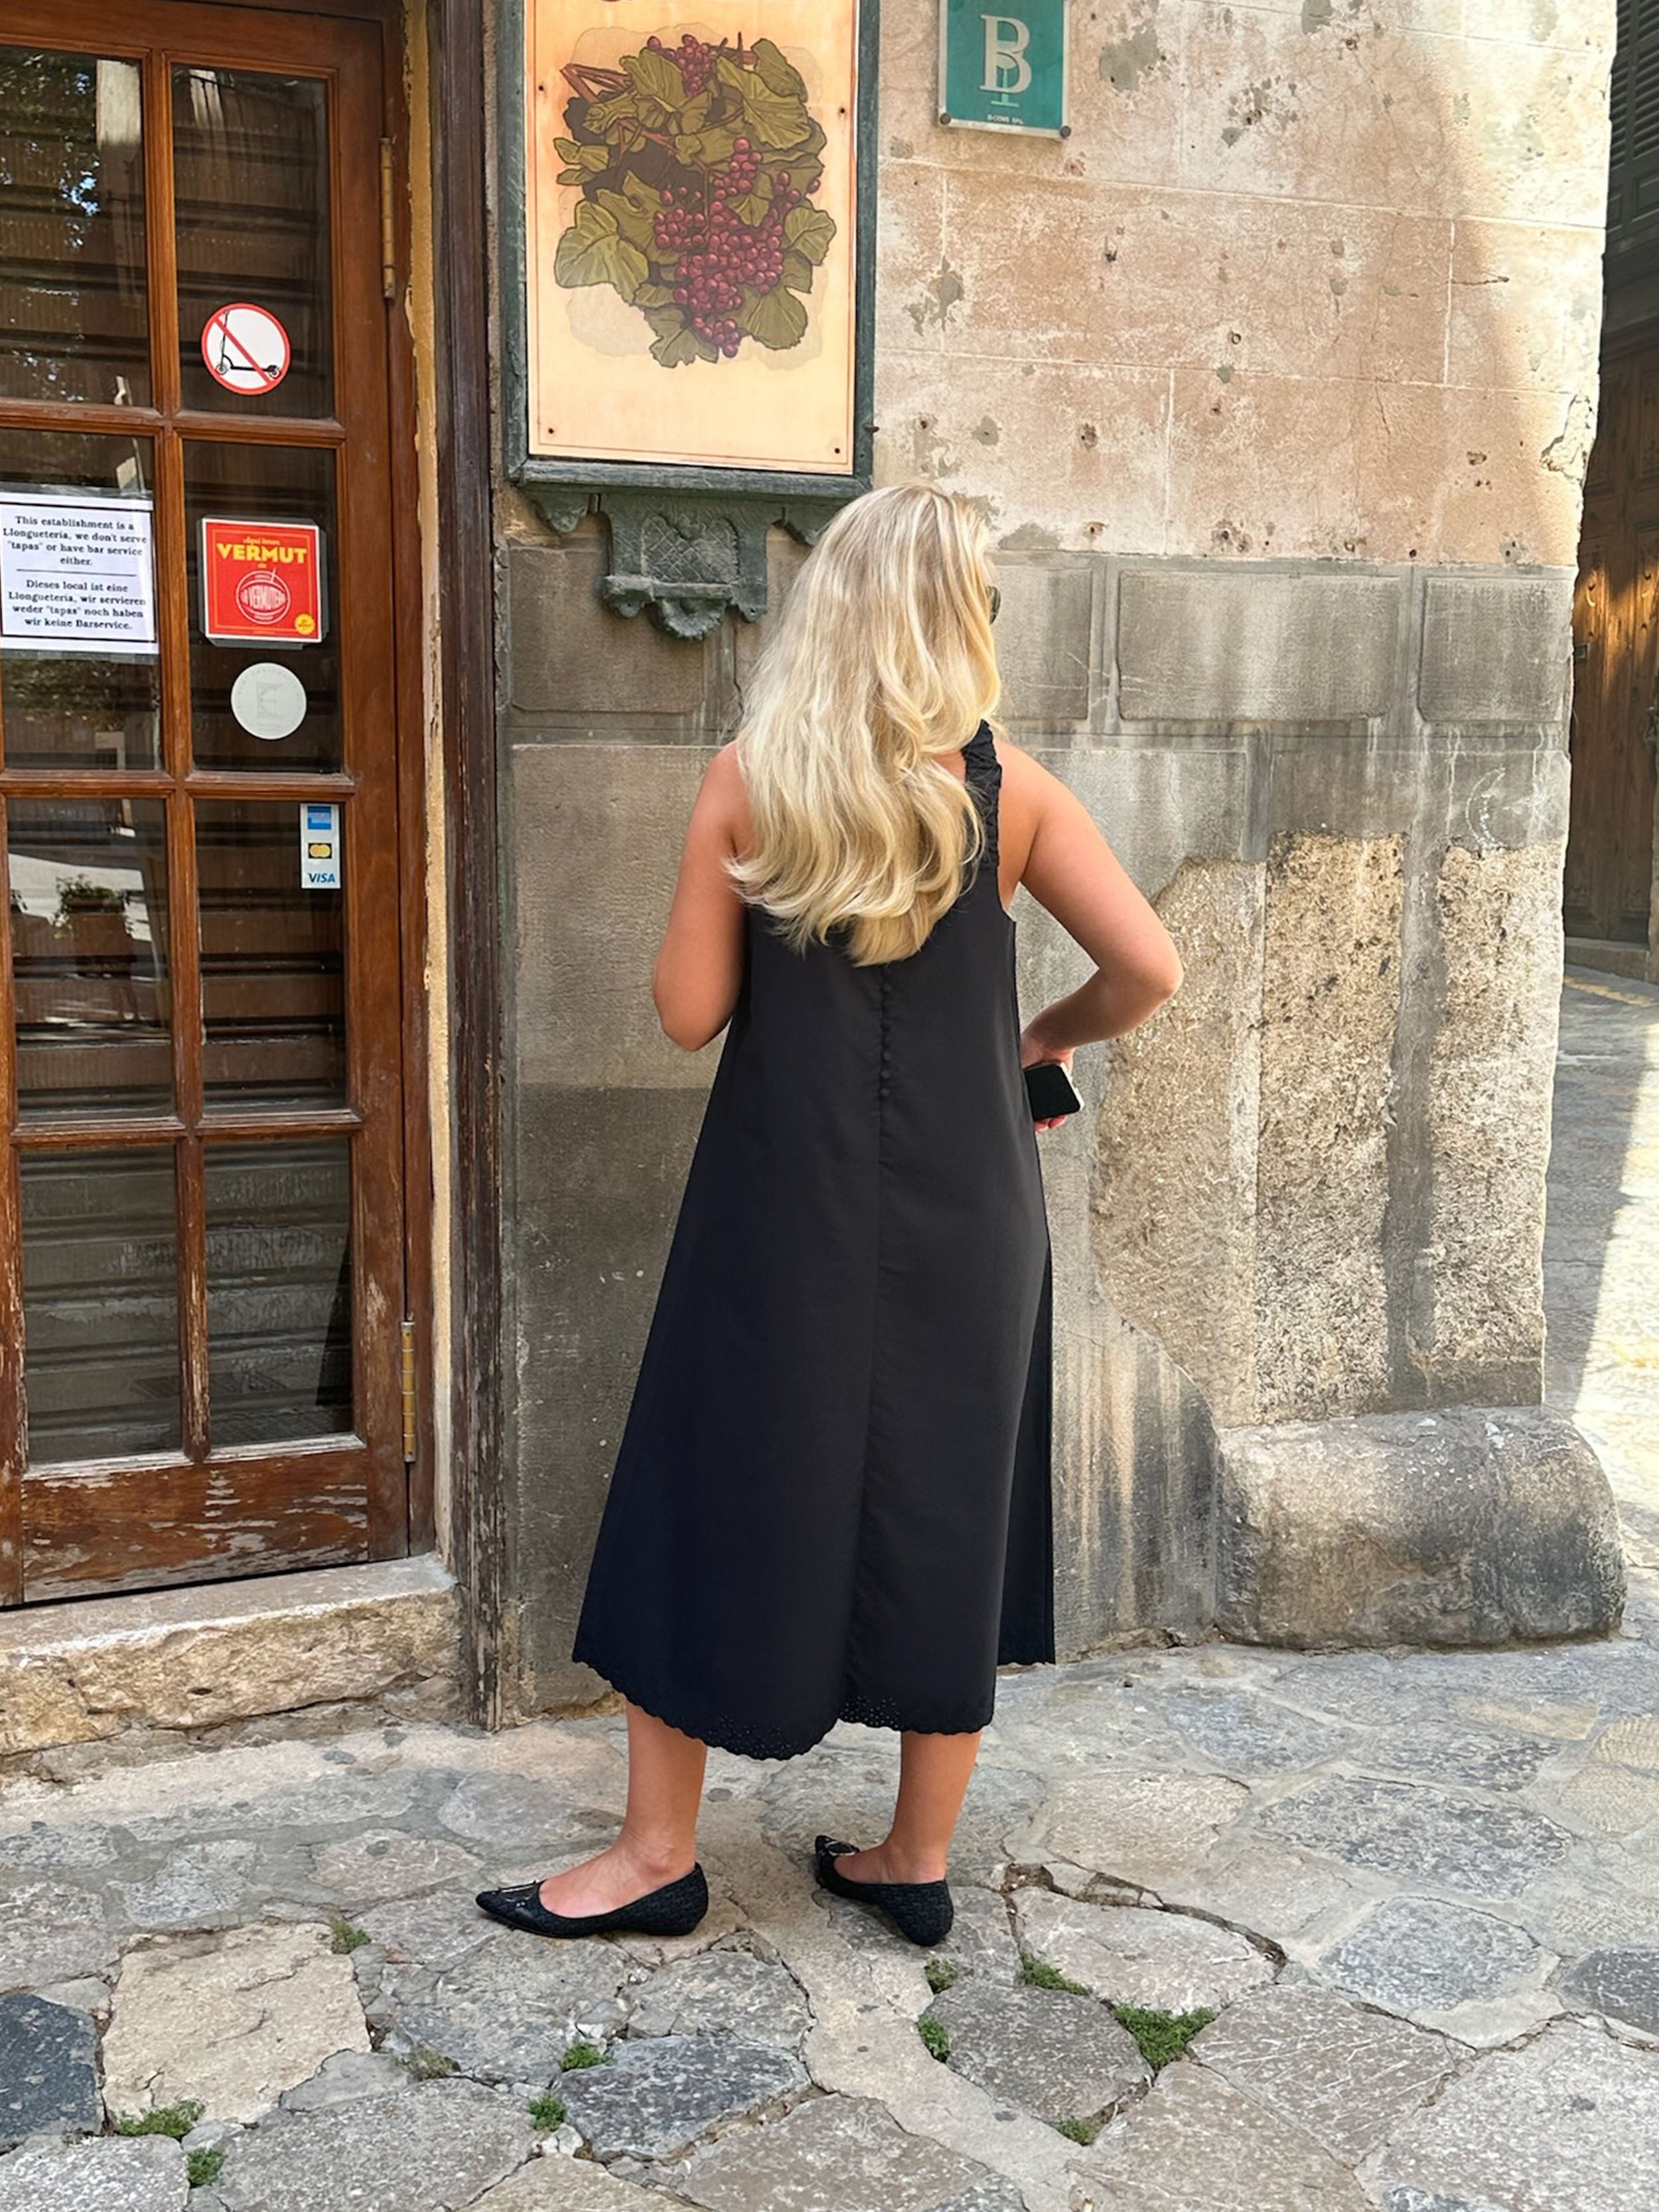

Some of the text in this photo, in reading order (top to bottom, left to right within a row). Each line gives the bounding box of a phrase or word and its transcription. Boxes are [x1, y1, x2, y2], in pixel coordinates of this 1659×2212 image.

[979, 14, 1032, 94] B
[15, 515, 38, 525] This
[41, 518, 113, 530] establishment
[117, 521, 125, 530] is
[92, 532, 117, 542] don't
[120, 536, 147, 544] serve
[7, 540, 43, 552] "tapas"
[60, 543, 84, 553] have
[87, 544, 104, 553] bar
[108, 546, 143, 556] service
[216, 542, 308, 563] VERMUT
[60, 556, 92, 565] either.
[27, 579, 128, 592] Dieses local ist eine
[100, 597, 146, 605] servieren
[13, 605, 143, 618] weder "tapas" noch haben
[44, 618, 73, 627] keine
[76, 619, 132, 630] Barservice.
[308, 873, 335, 883] VISA
